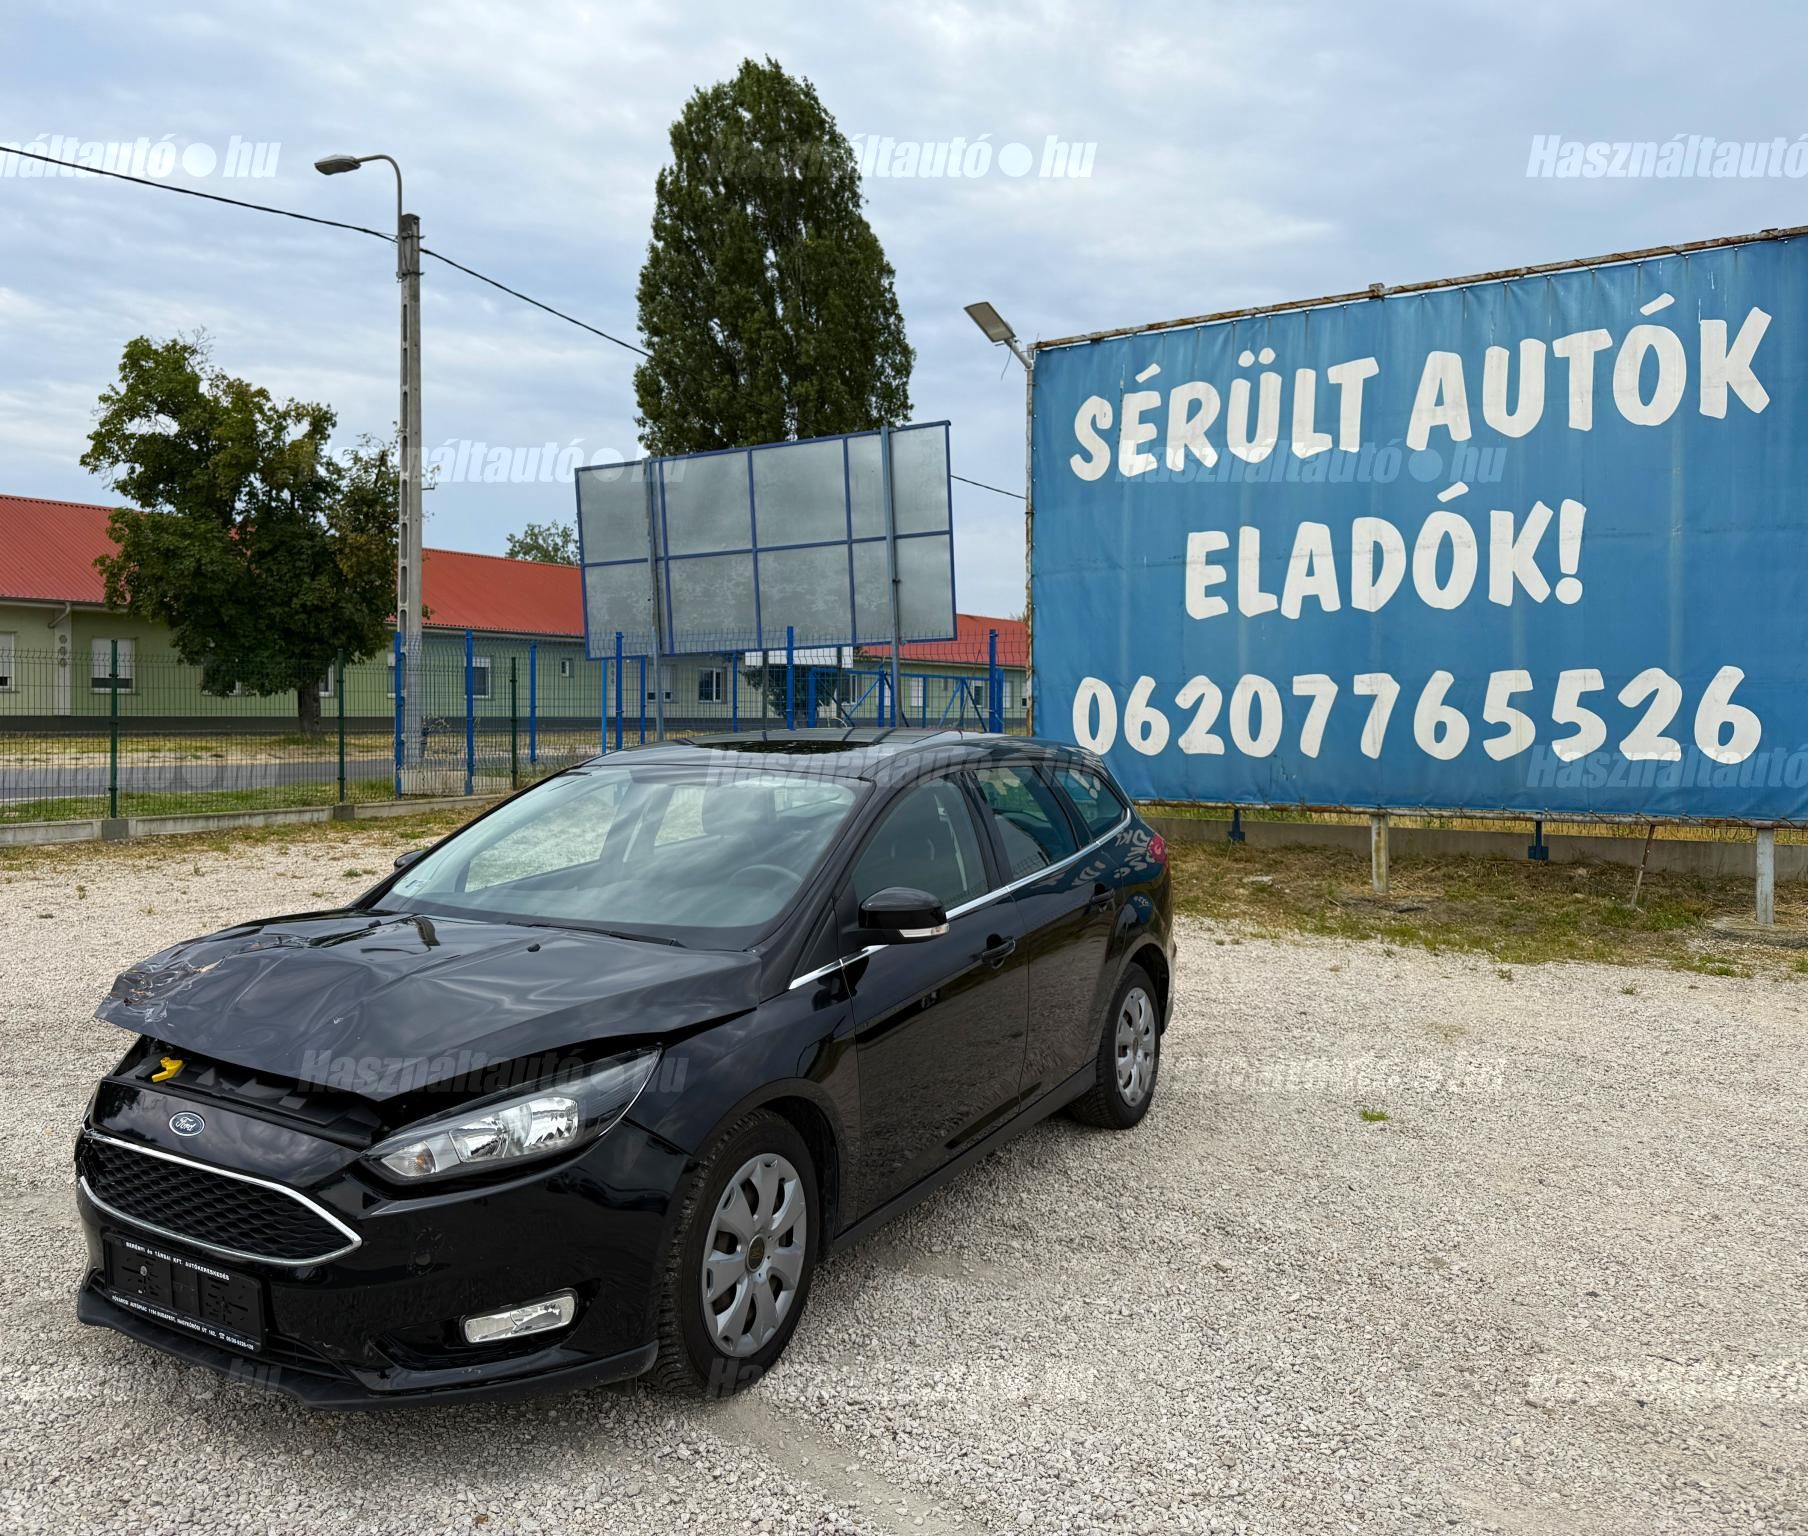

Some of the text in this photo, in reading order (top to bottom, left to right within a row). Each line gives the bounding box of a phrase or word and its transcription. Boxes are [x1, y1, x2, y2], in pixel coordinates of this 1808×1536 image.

[1069, 293, 1773, 482] SÉRÜLT AUTÓK
[1184, 481, 1587, 620] ELADÓK!
[1071, 665, 1764, 766] 06207765526
[176, 1115, 198, 1133] Ford
